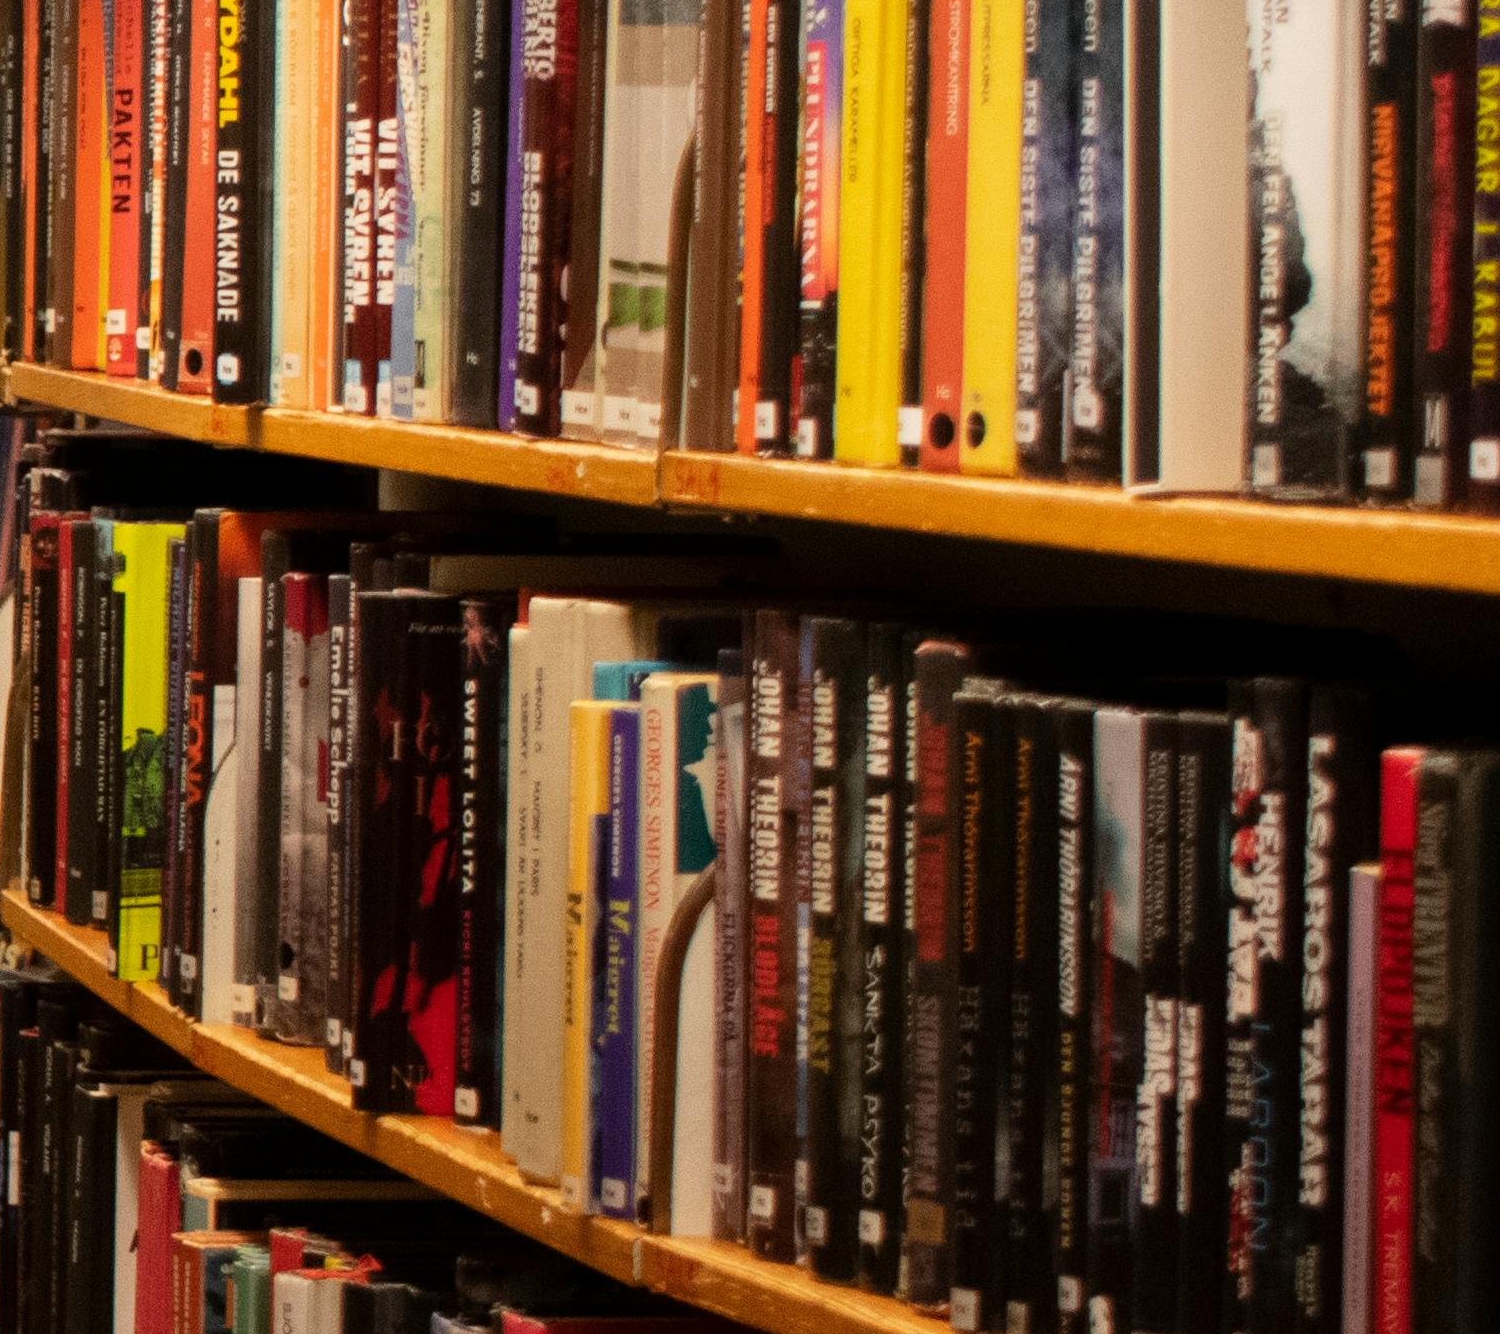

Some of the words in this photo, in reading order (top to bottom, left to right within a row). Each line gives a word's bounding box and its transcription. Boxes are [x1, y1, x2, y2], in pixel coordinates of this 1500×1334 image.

[112, 88, 133, 214] PAKTEN
[1079, 78, 1097, 136] DEN
[217, 150, 238, 185] DE
[216, 196, 238, 322] SAKNADE
[329, 625, 346, 713] Emelie
[325, 722, 345, 825] Schepp
[461, 679, 476, 781] SWEET
[460, 792, 475, 894] LOLITA
[1253, 793, 1284, 961] HENRIK
[1300, 735, 1335, 1009] LASAROS
